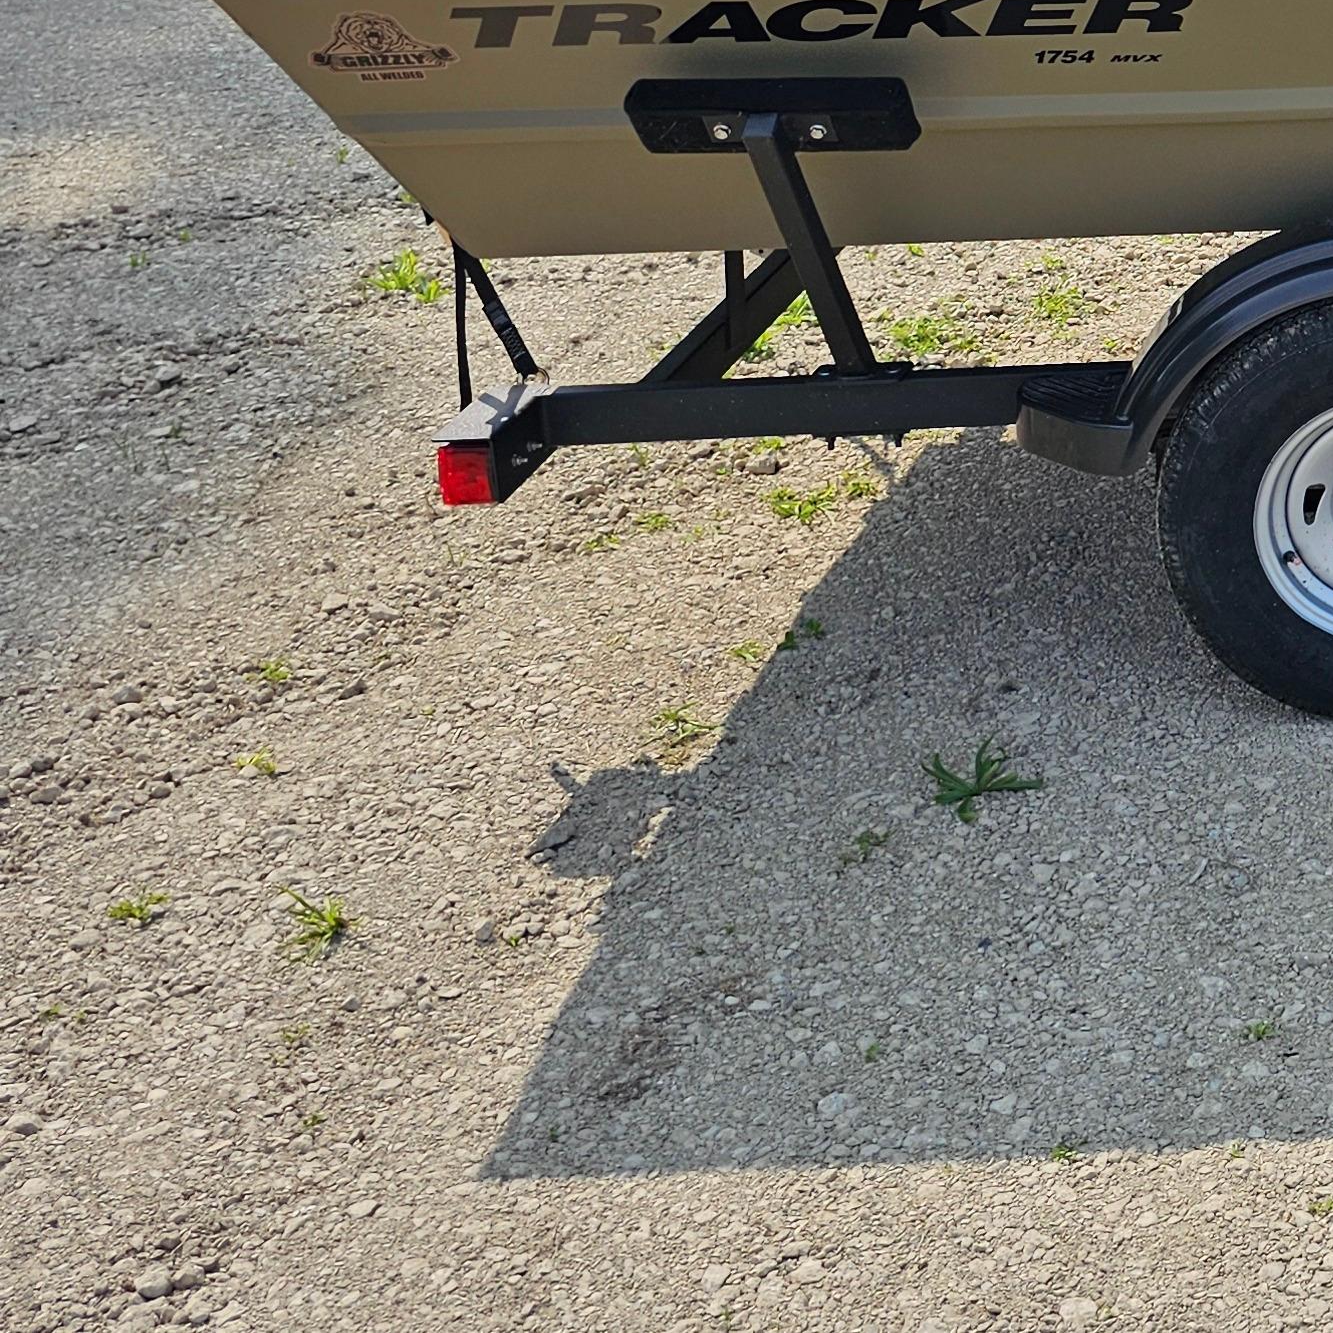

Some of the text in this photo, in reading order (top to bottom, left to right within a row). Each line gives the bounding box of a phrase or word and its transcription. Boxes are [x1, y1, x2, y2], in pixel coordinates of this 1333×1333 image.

[341, 53, 426, 67] GRIZZLY
[1034, 49, 1162, 64] 1754 MVX
[361, 70, 425, 82] ALL WELDED
